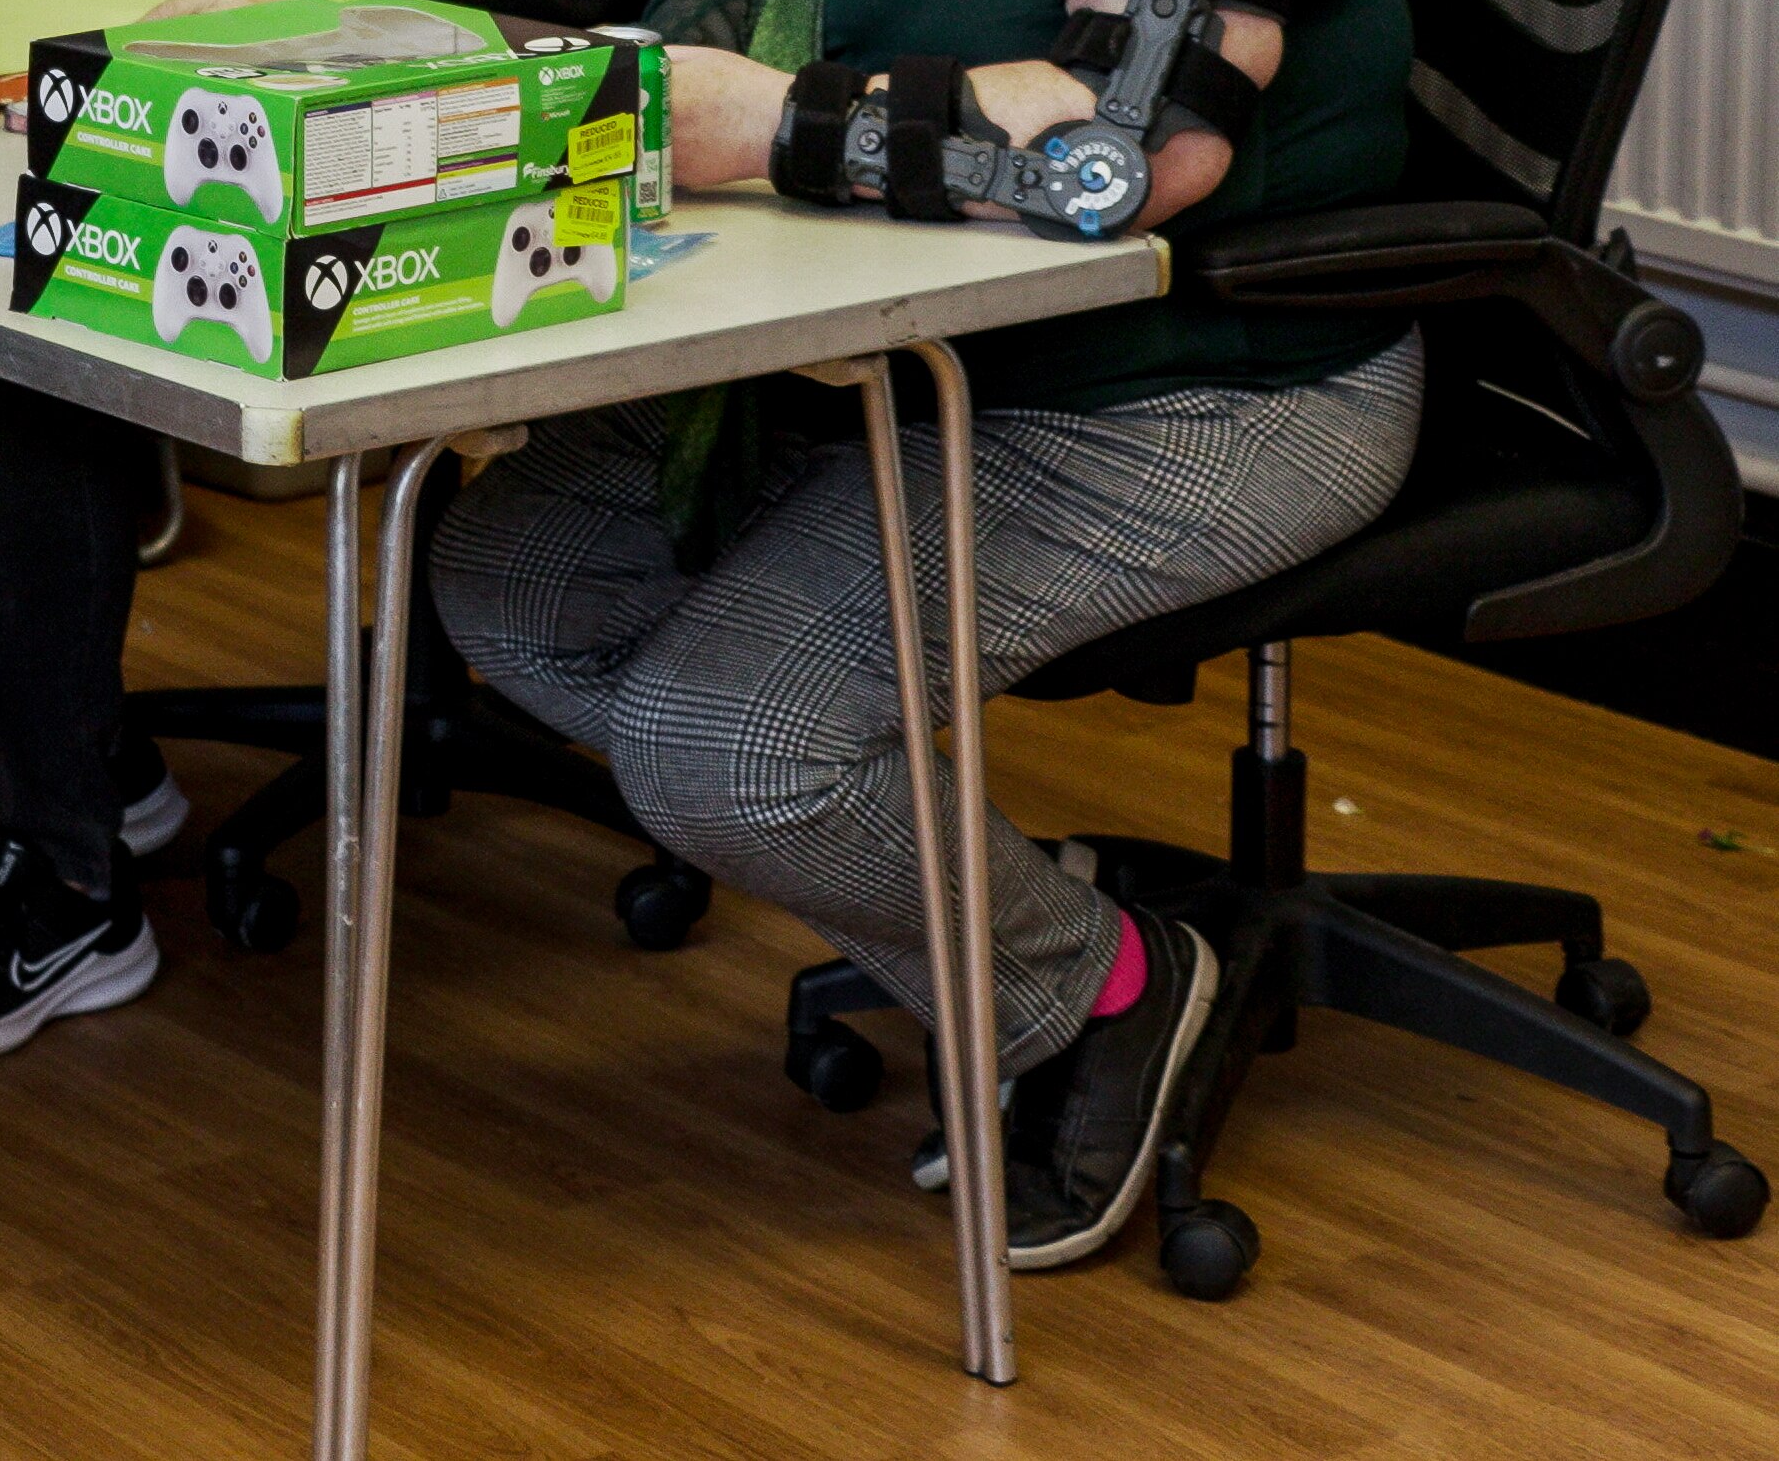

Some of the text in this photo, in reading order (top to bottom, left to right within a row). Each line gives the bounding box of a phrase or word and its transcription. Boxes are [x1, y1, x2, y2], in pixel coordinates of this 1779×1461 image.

[554, 65, 586, 81] XBOX
[77, 84, 153, 135] XBOX
[580, 120, 617, 138] REDUCED
[77, 131, 153, 158] CONTROLLER CAKE
[573, 195, 609, 209] REDUCED
[65, 219, 142, 270] XBOX
[65, 265, 140, 294] CONTROLLER CAKE
[353, 246, 440, 295] XBOX
[354, 299, 400, 315] CONTROLLER
[401, 295, 421, 307] CAKE
